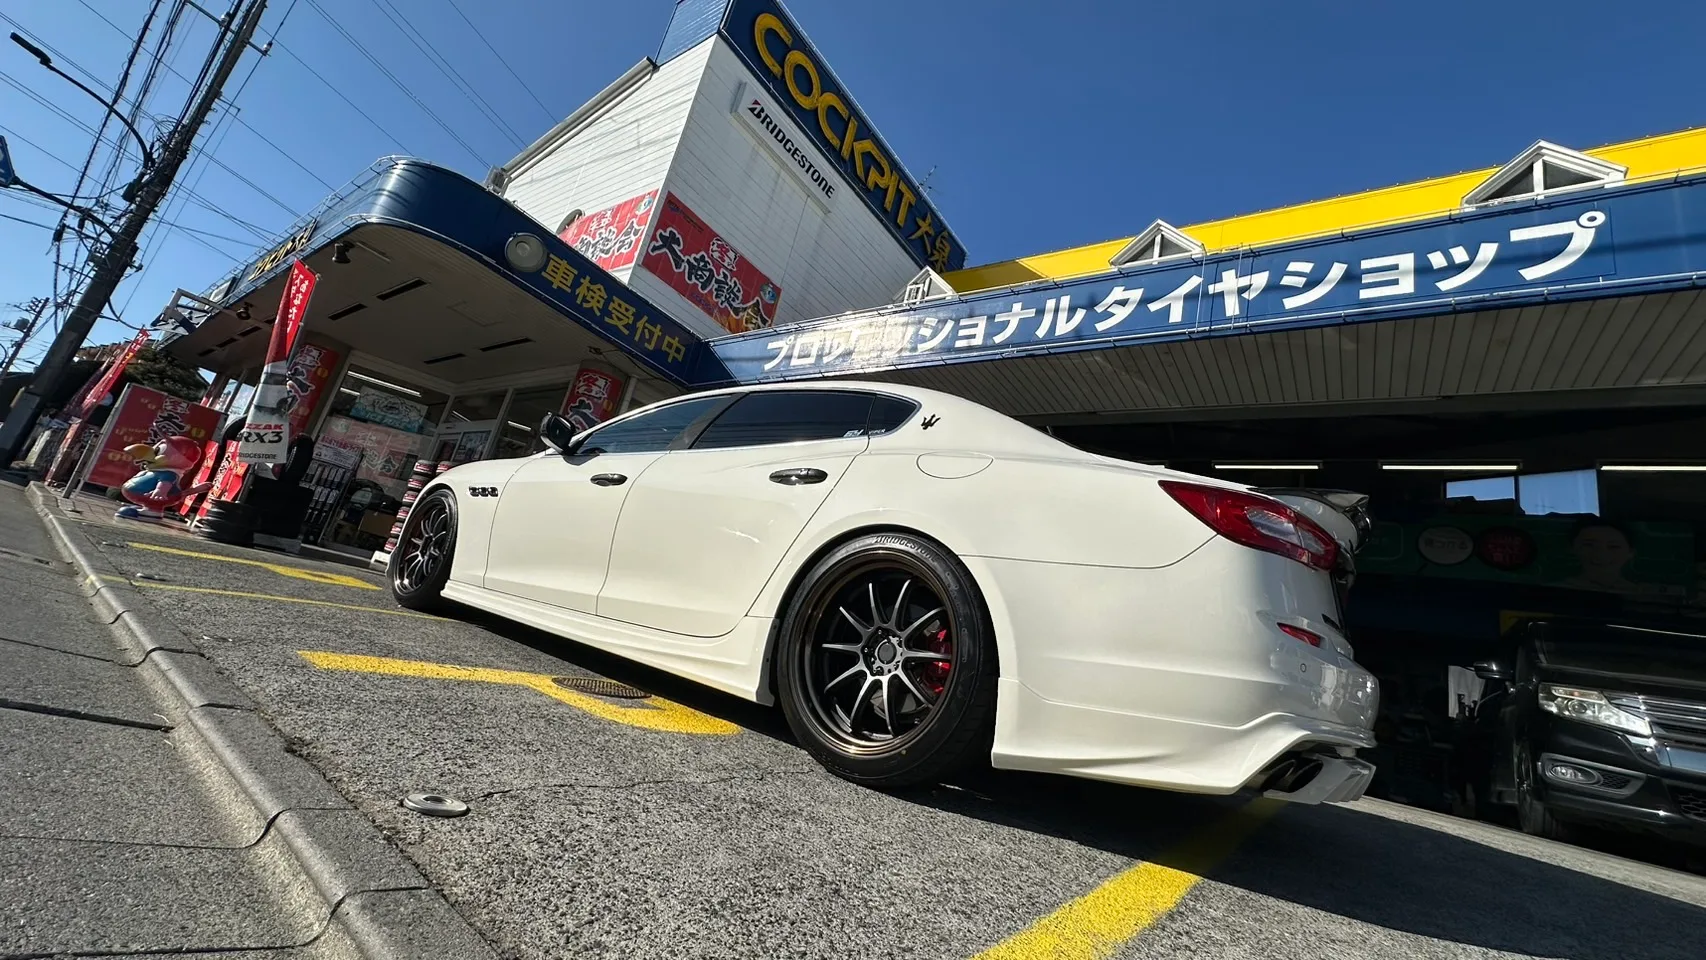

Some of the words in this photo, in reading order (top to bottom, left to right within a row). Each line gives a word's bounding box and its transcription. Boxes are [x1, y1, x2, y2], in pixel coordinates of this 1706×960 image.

[747, 99, 836, 199] BRIDGESTONE
[754, 12, 917, 229] COCKPIT
[907, 211, 949, 274] 大泉
[541, 254, 686, 364] 車検受付中
